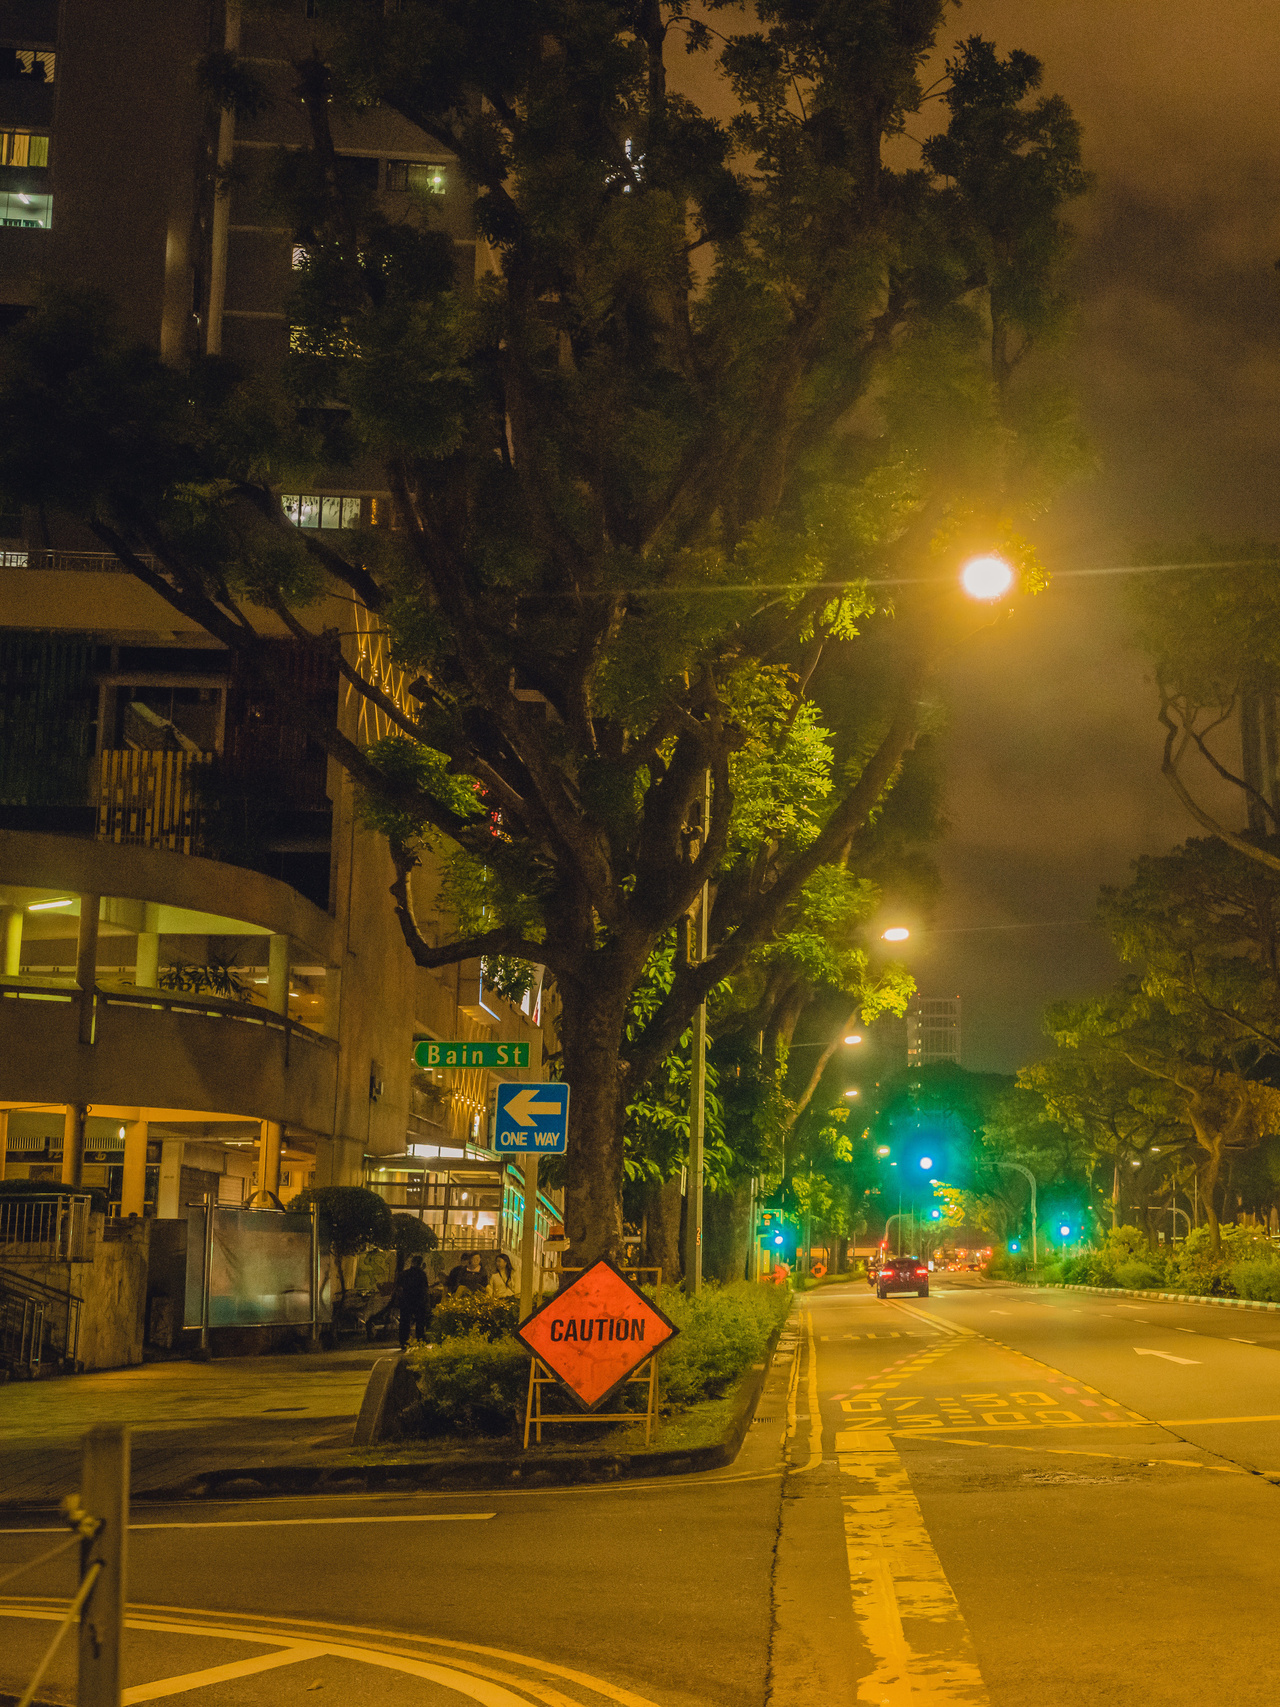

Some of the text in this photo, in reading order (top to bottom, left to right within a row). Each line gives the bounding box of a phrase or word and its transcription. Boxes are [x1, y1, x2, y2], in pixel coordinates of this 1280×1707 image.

[427, 1045, 522, 1065] Bain St
[500, 1131, 561, 1146] ONE WAY
[550, 1318, 646, 1342] CAUTION
